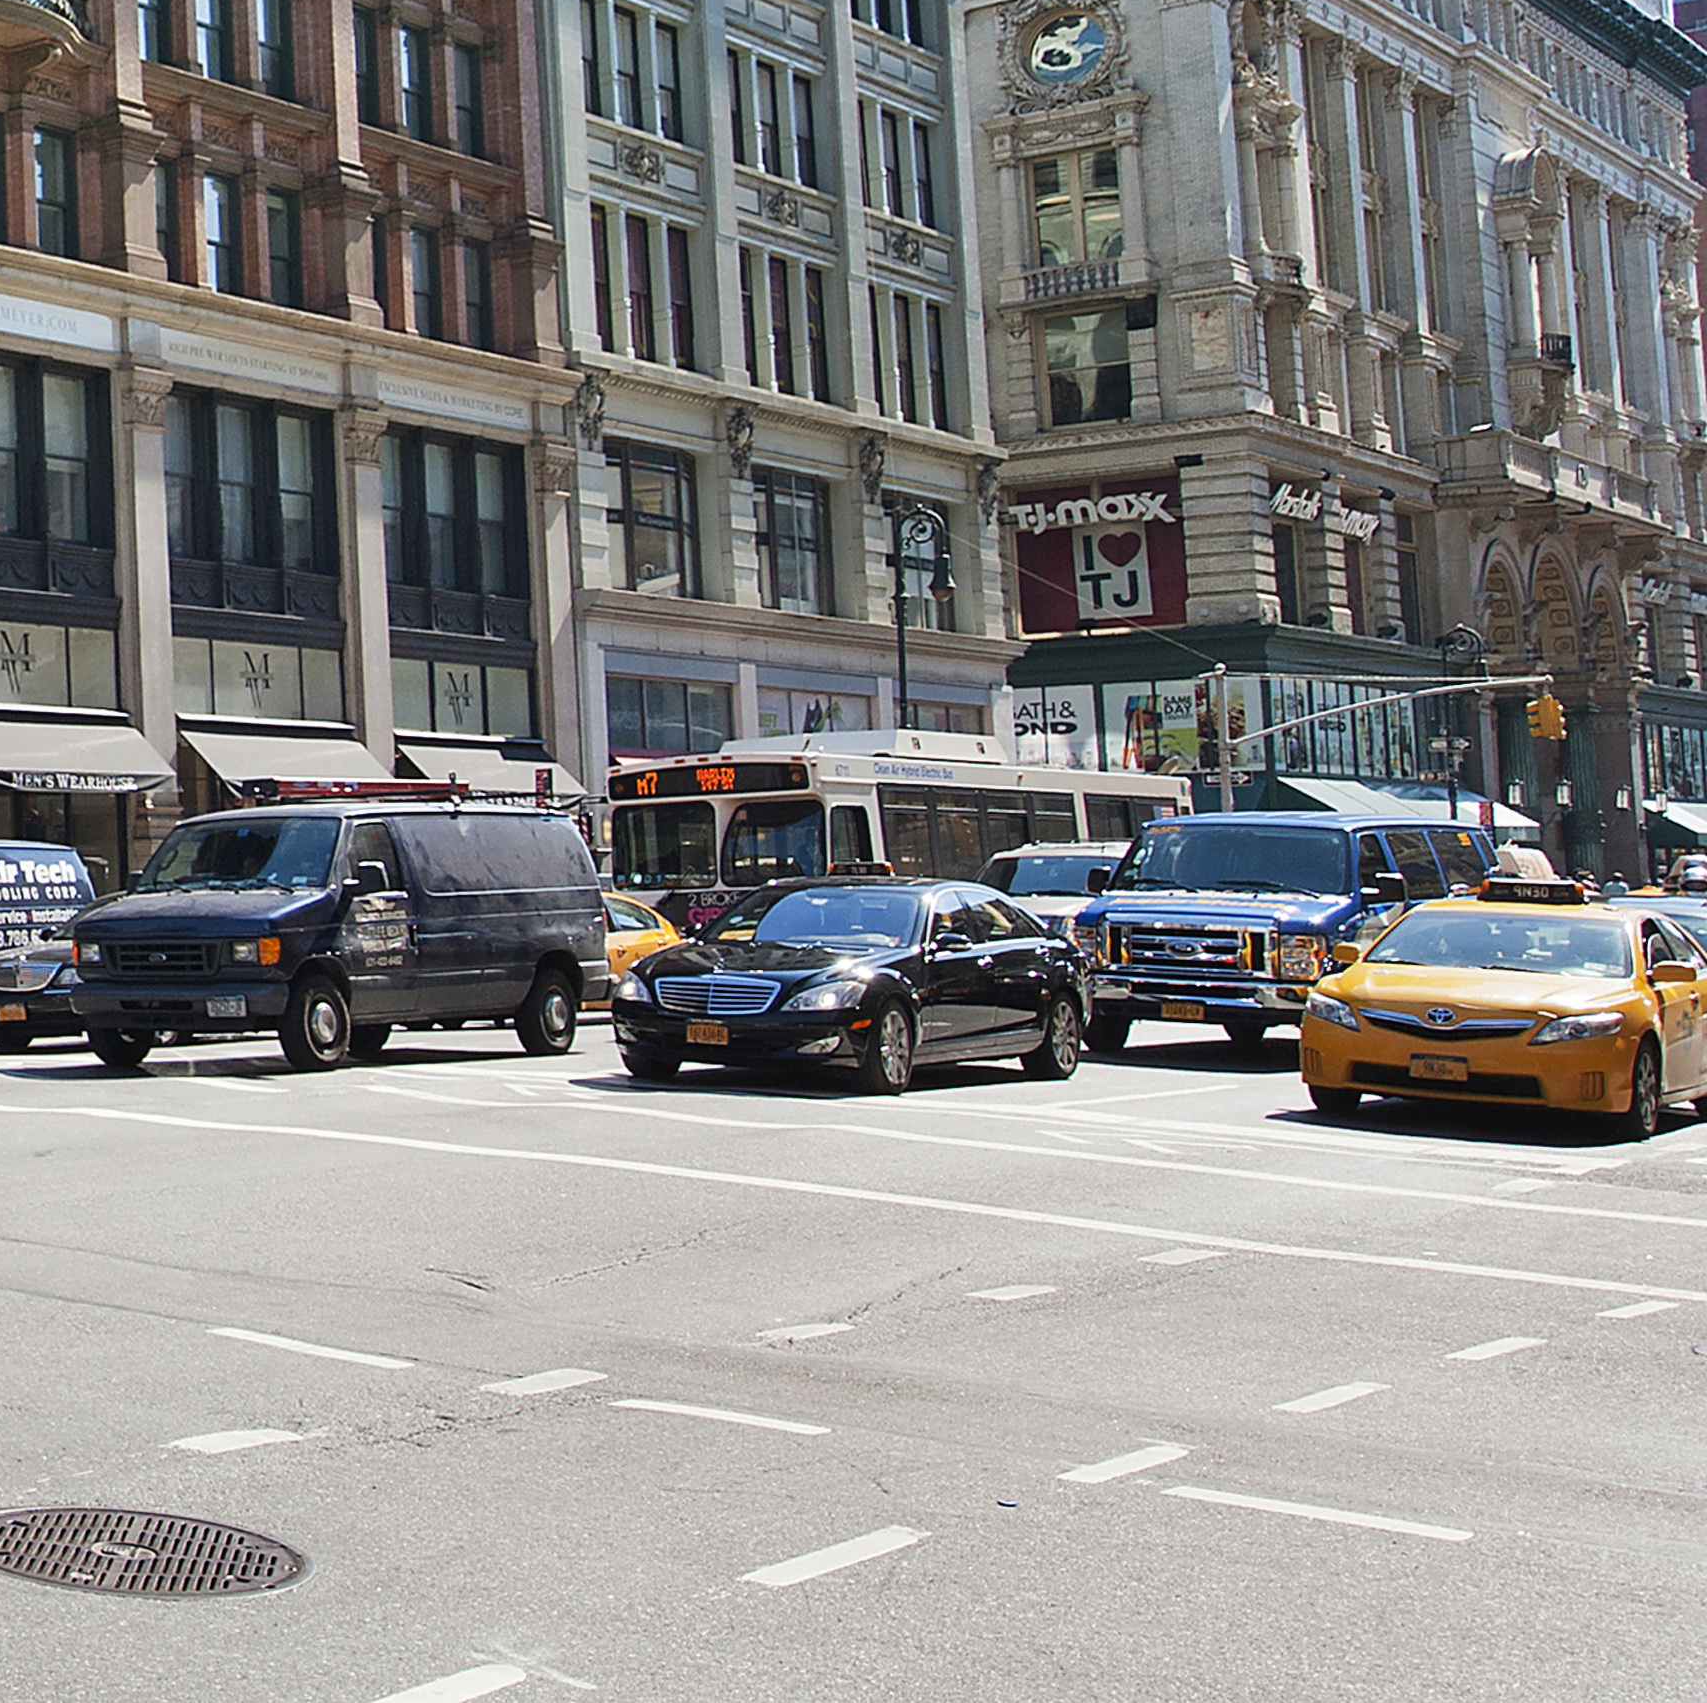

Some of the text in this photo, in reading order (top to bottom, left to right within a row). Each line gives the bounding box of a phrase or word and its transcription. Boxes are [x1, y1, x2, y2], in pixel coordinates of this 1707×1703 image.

[1164, 702, 1192, 714] DAY
[696, 768, 735, 782] HARLEM
[873, 762, 954, 778] Clean Air Hybrid Electric Bus
[636, 772, 658, 795] M7
[18, 861, 76, 883] Tech
[44, 886, 82, 899] CORP.
[689, 894, 698, 907] 2
